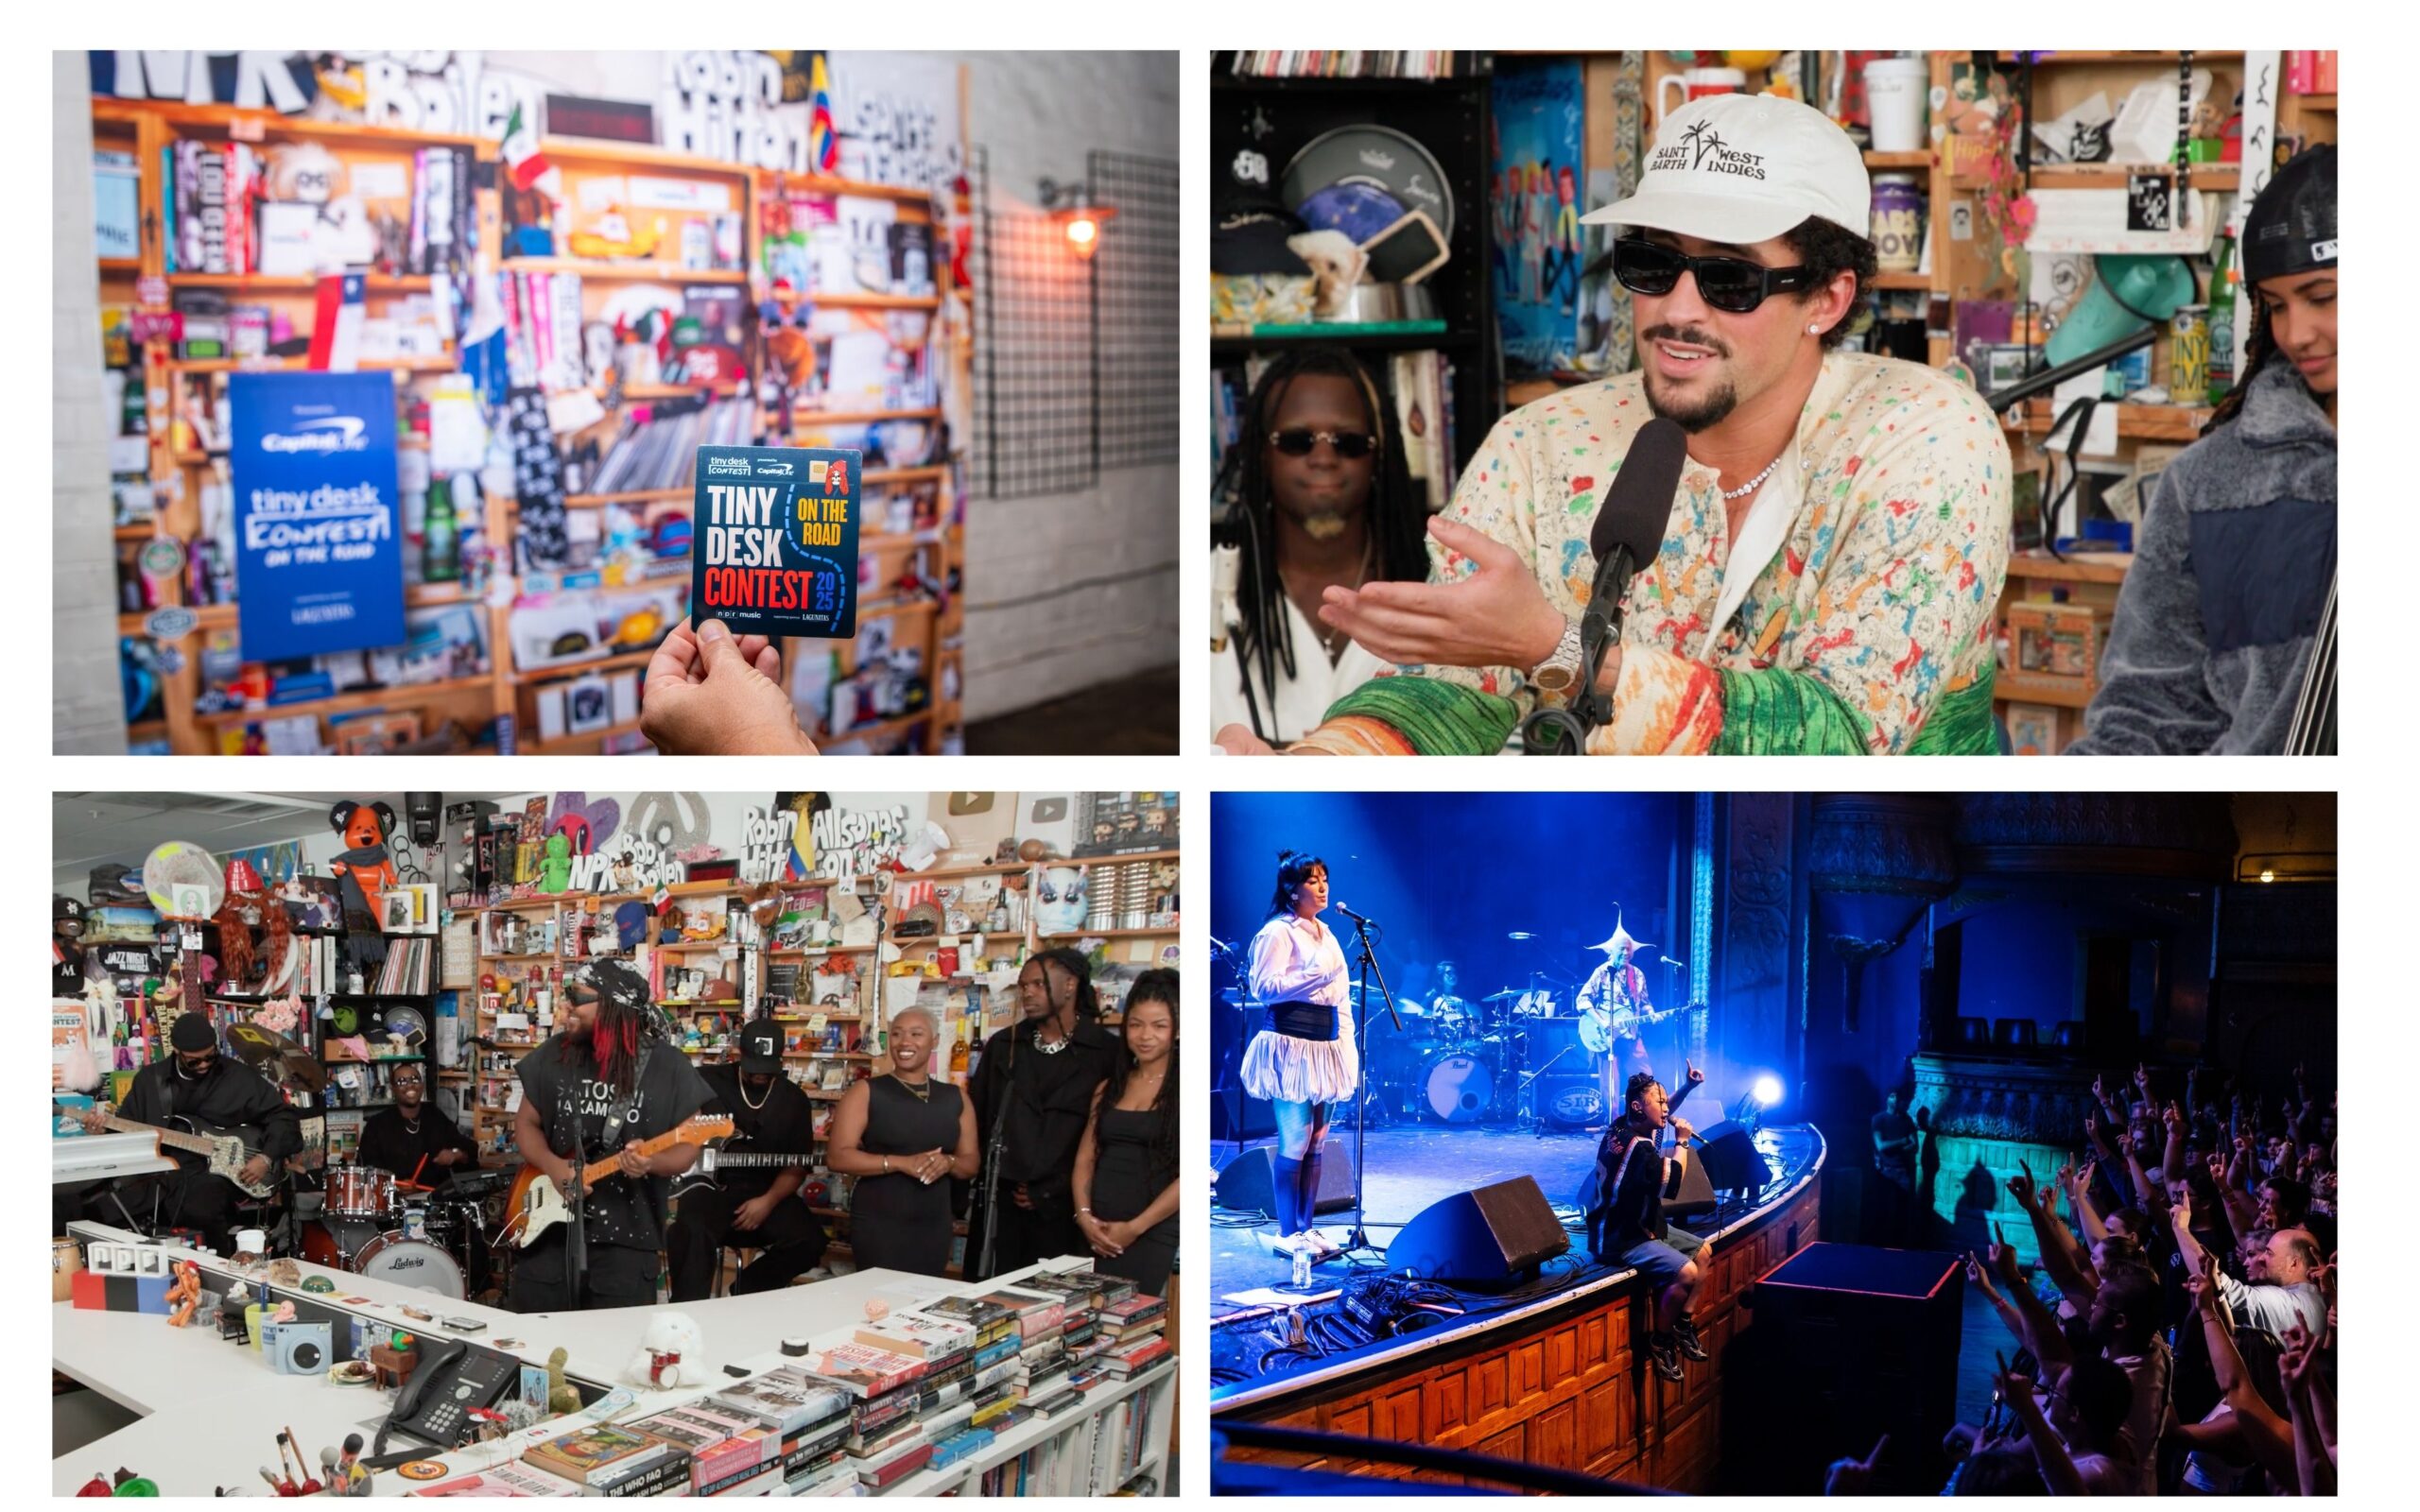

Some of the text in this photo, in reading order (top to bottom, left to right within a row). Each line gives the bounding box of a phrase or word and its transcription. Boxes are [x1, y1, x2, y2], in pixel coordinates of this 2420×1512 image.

[1656, 146, 1690, 159] SAINT
[1650, 159, 1688, 171] BARTH
[1707, 161, 1766, 180] INDIES
[711, 456, 749, 466] tiny desk
[711, 467, 749, 475] CONTEST
[251, 481, 381, 521] tiny desk
[707, 485, 778, 526] TINY
[798, 498, 849, 523] ON THE
[251, 516, 380, 549] CONTEST
[803, 523, 841, 546] ROAD
[706, 526, 784, 568] DESK
[704, 567, 814, 610] CONTEST
[816, 572, 835, 592] 20
[816, 592, 834, 610] 25
[803, 613, 830, 622] LAGUNITAS
[741, 805, 798, 847] Robin
[622, 833, 656, 865] Bob
[567, 852, 621, 892] NPR
[633, 850, 684, 890] Boilen
[104, 951, 148, 965] JAZZ NIGHT
[127, 963, 150, 973] AMERICA
[1560, 1096, 1597, 1108] SIR
[94, 1246, 156, 1271] npr
[389, 1257, 424, 1271] Ludwig
[608, 1486, 625, 1497] THE
[625, 1476, 645, 1492] WHO
[646, 1468, 663, 1484] FAQ
[650, 1483, 664, 1496] FAQ
